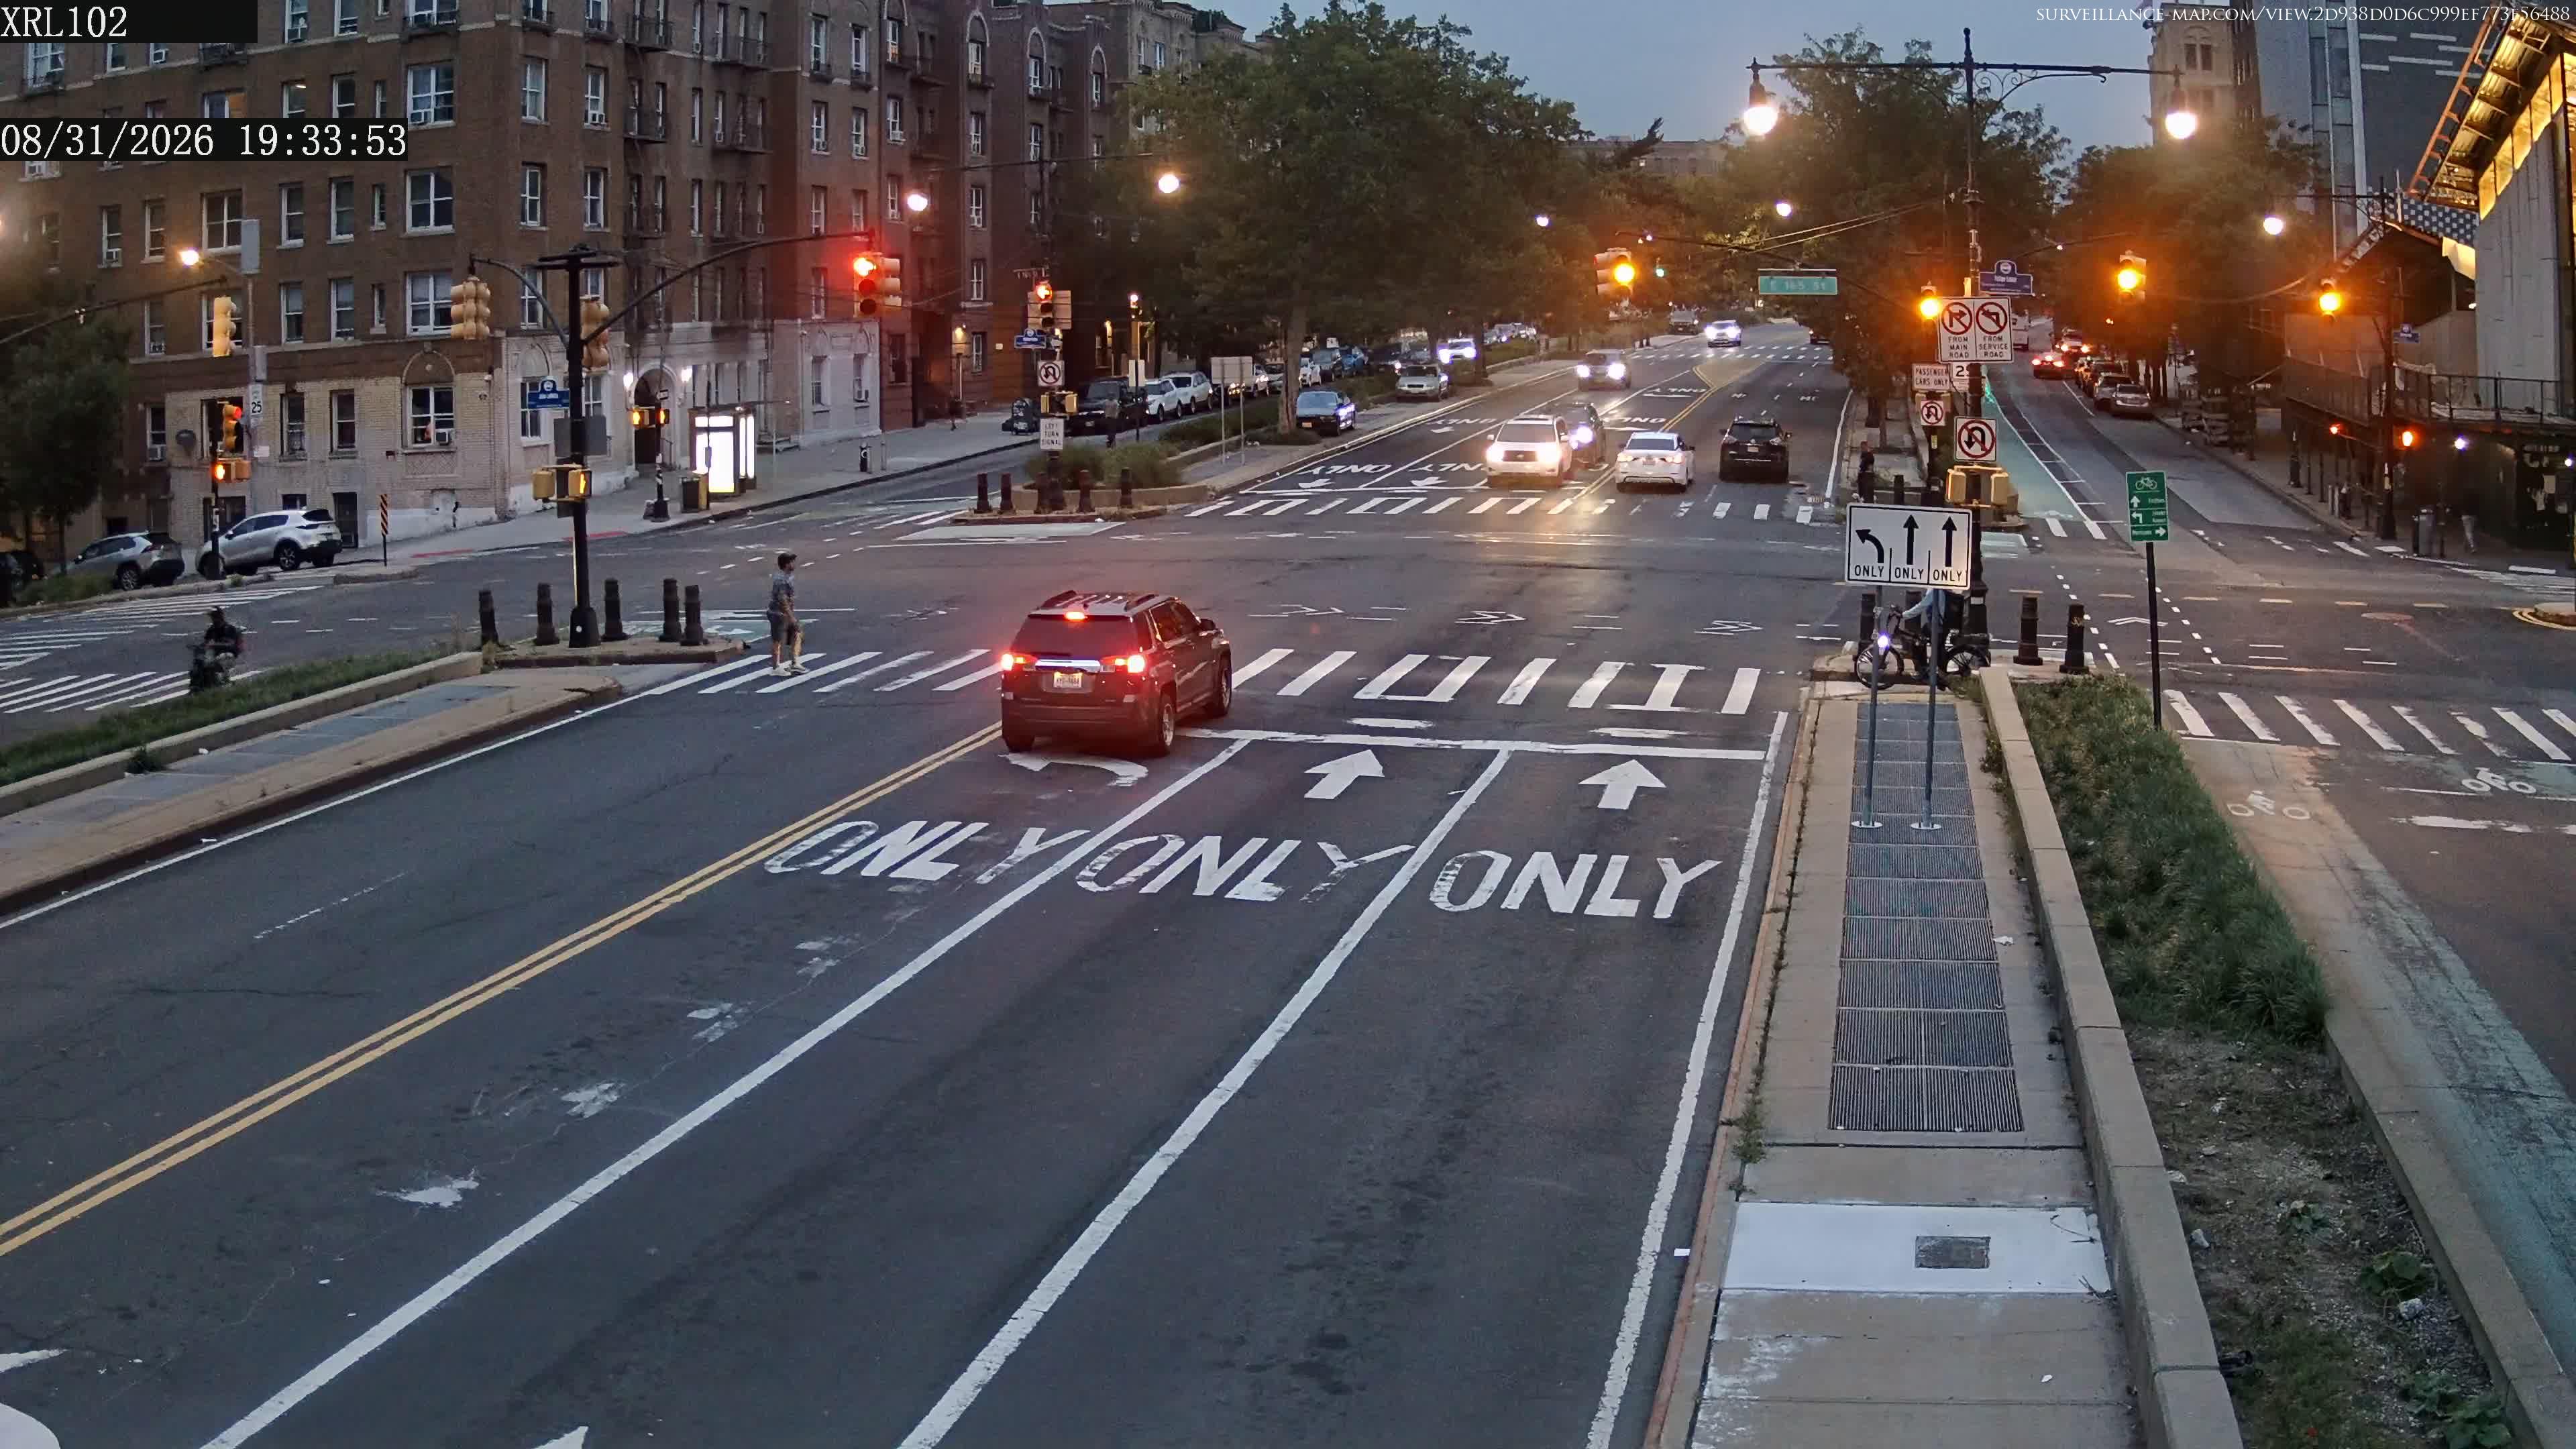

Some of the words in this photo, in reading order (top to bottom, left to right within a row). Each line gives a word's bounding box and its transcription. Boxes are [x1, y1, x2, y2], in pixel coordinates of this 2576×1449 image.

[252, 400, 262, 413] 25
[1854, 565, 1884, 577] ONLY
[1894, 568, 1923, 580] ONLY
[1933, 570, 1962, 582] ONLY
[764, 820, 1091, 884] ONLY
[1075, 834, 1417, 903] ONLY
[1429, 850, 1723, 918] ONLY
